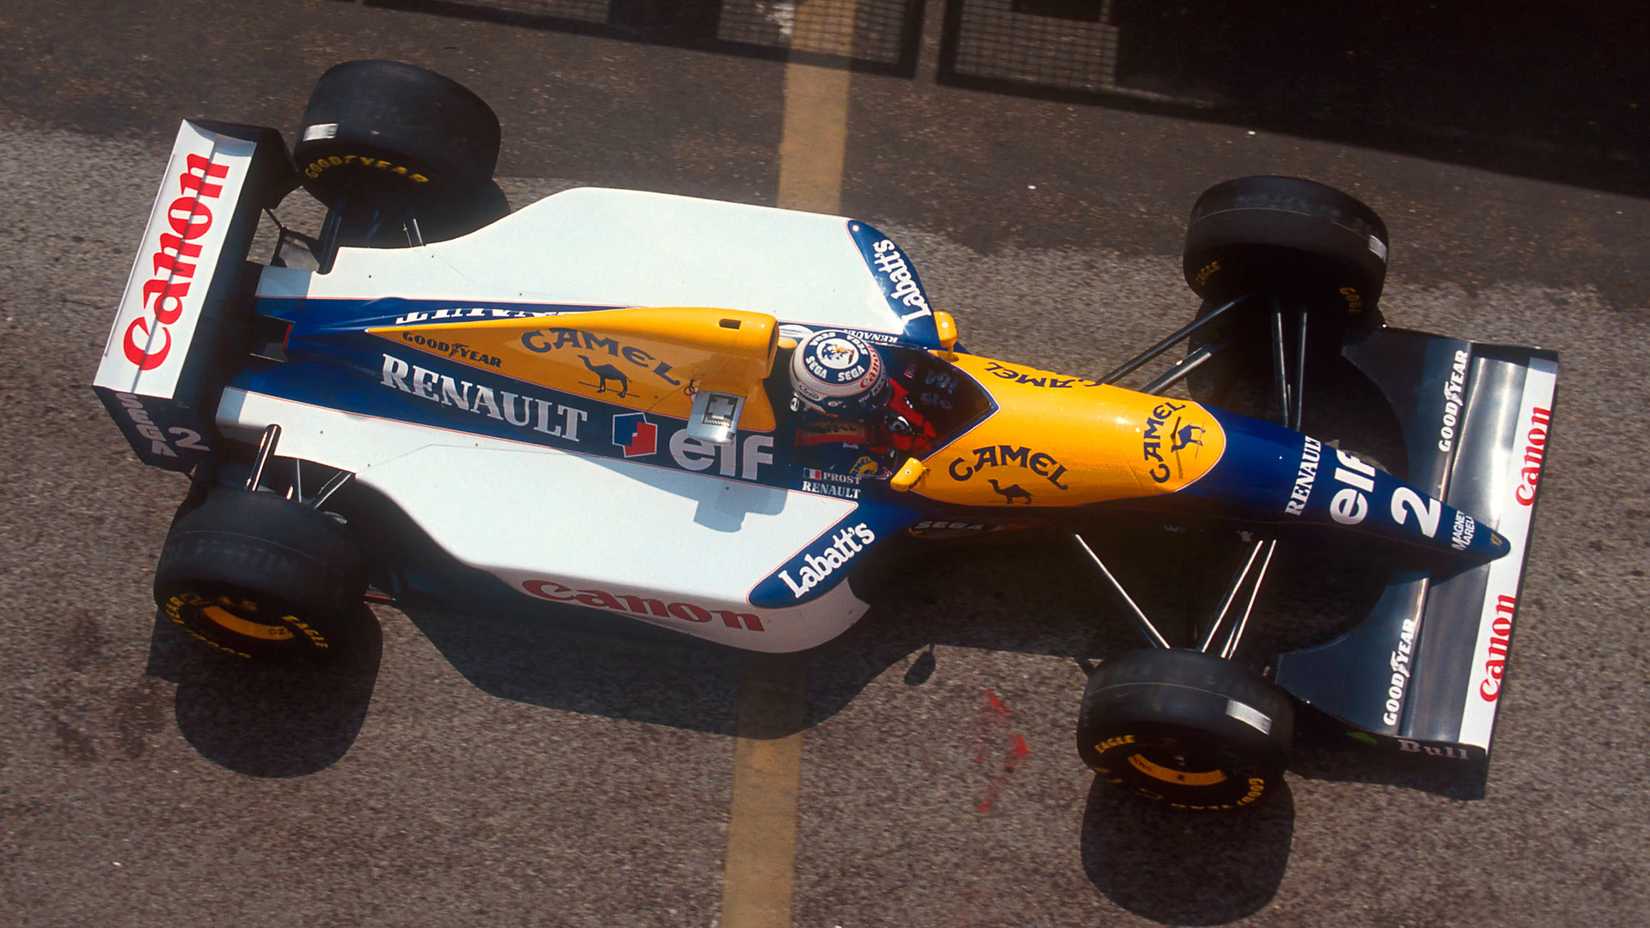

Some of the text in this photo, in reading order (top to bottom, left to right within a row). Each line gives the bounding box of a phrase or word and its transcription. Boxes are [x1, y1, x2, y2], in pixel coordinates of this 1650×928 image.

[123, 152, 231, 371] Canon
[872, 239, 932, 321] Labatt's
[402, 331, 503, 369] GOODYEAR
[521, 327, 681, 386] CAMEL
[805, 355, 829, 379] SEGA
[837, 364, 866, 382] SEGA
[379, 353, 588, 442] RENAULT
[1438, 349, 1469, 452] GOODYEAR
[168, 426, 211, 452] 2
[669, 427, 776, 482] elf
[949, 444, 1069, 491] CAMEL
[1143, 400, 1187, 484] CAMEL
[1515, 406, 1553, 508] Canon
[801, 480, 862, 500] RENAULT
[823, 471, 862, 485] PROST
[1329, 449, 1377, 526] elf
[1390, 486, 1442, 539] 2
[777, 522, 876, 599] Labatt's
[521, 579, 765, 632] Canon
[1383, 618, 1418, 726] GOODYEAR
[1479, 594, 1517, 703] Canon
